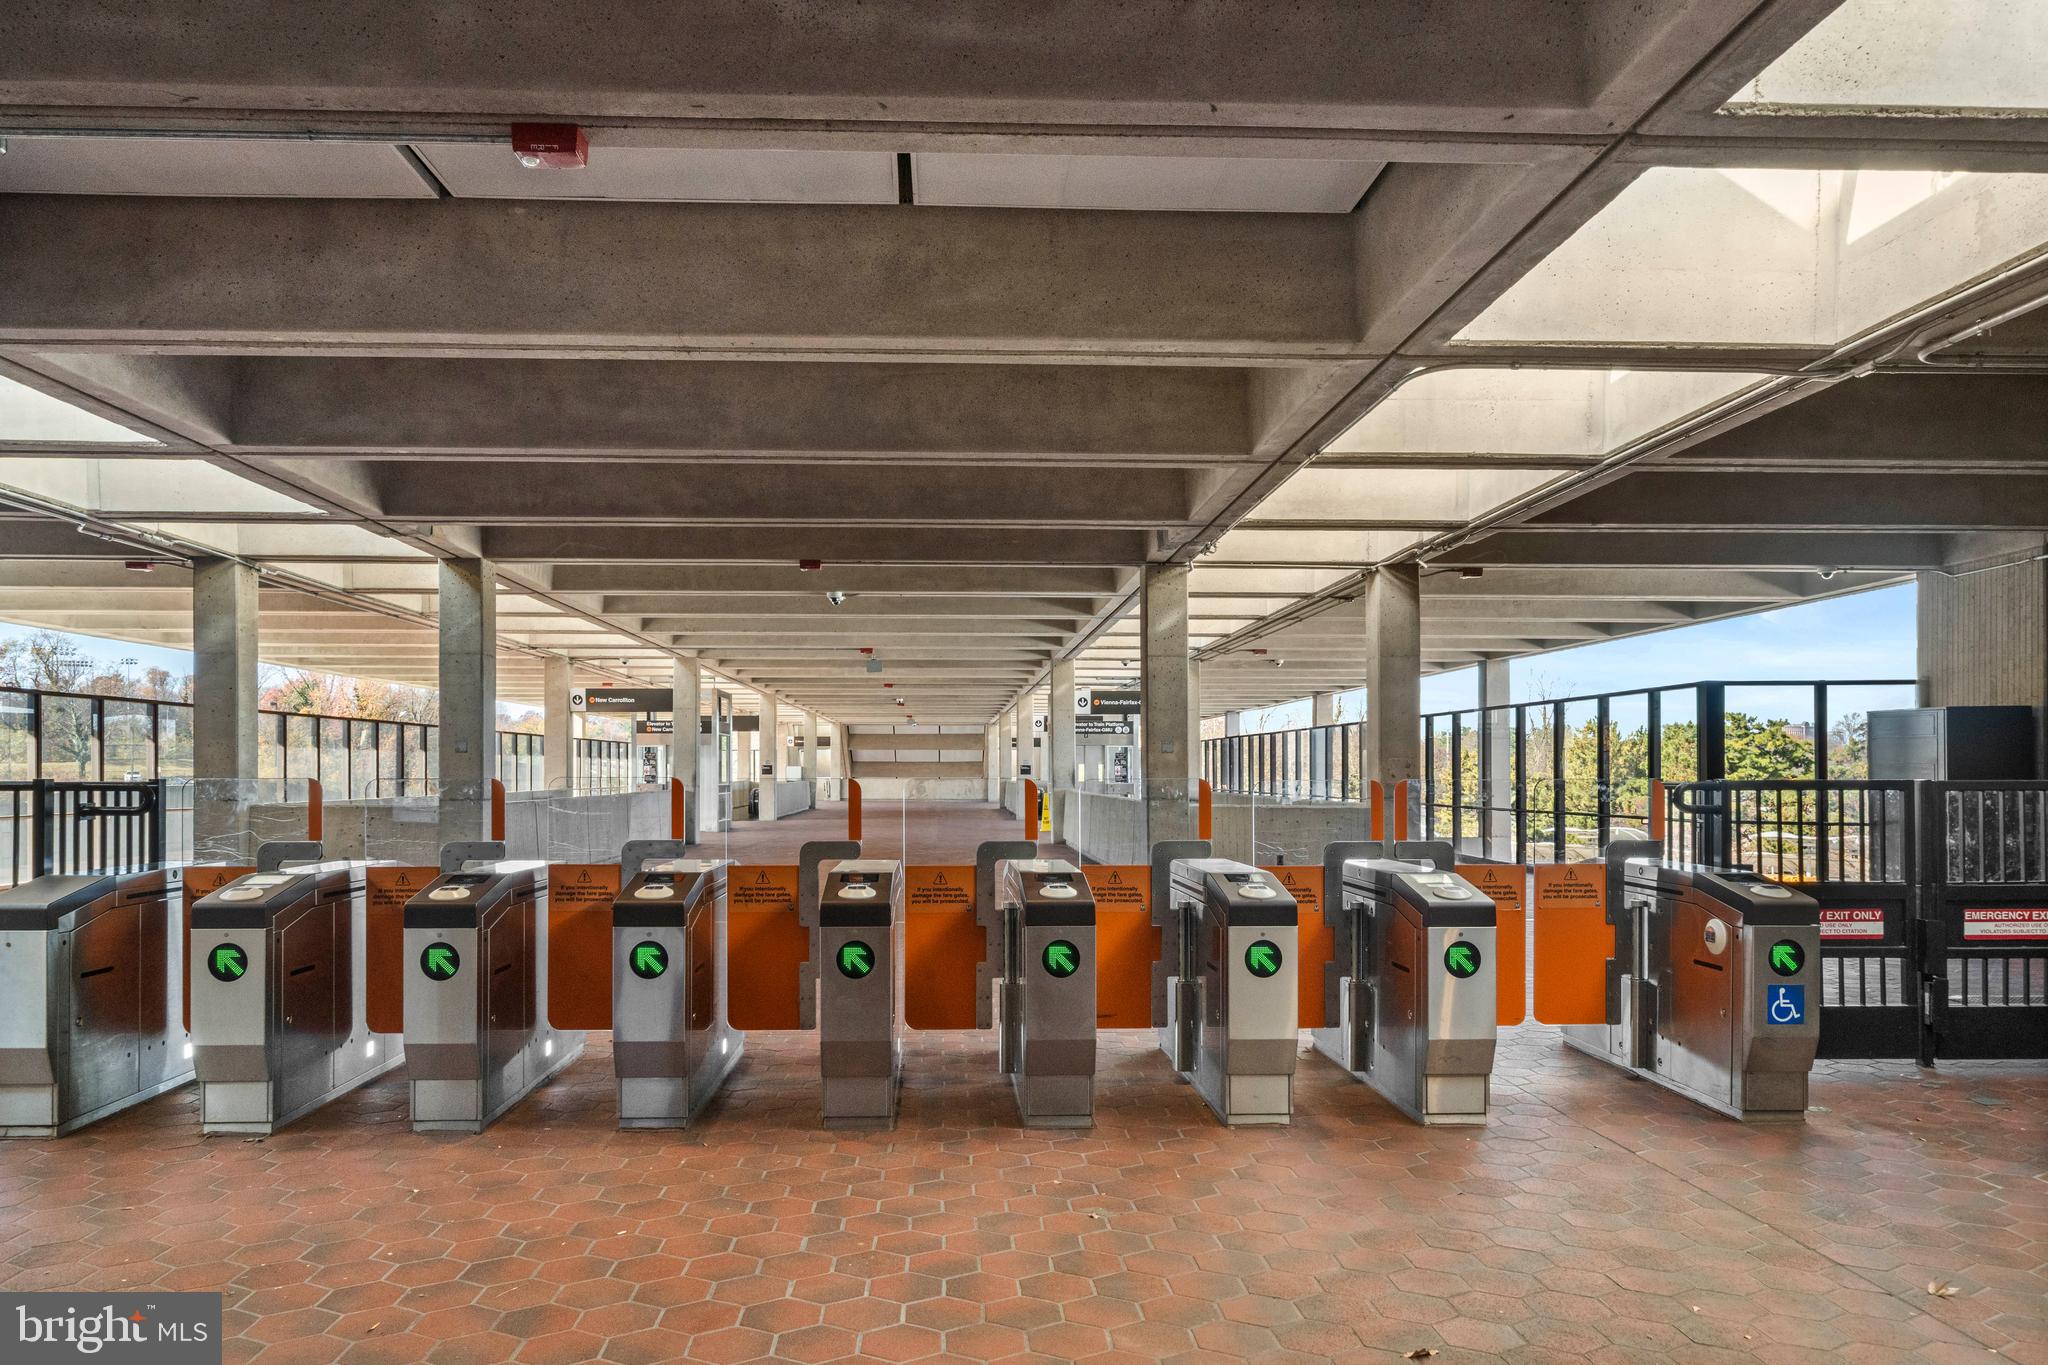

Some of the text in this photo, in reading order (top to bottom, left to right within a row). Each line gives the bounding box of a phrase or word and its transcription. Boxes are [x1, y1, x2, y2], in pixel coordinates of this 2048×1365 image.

[1826, 912, 1850, 920] EXIT
[1853, 911, 1881, 920] ONLY
[1964, 912, 2048, 920] EMERGENCY EXI
